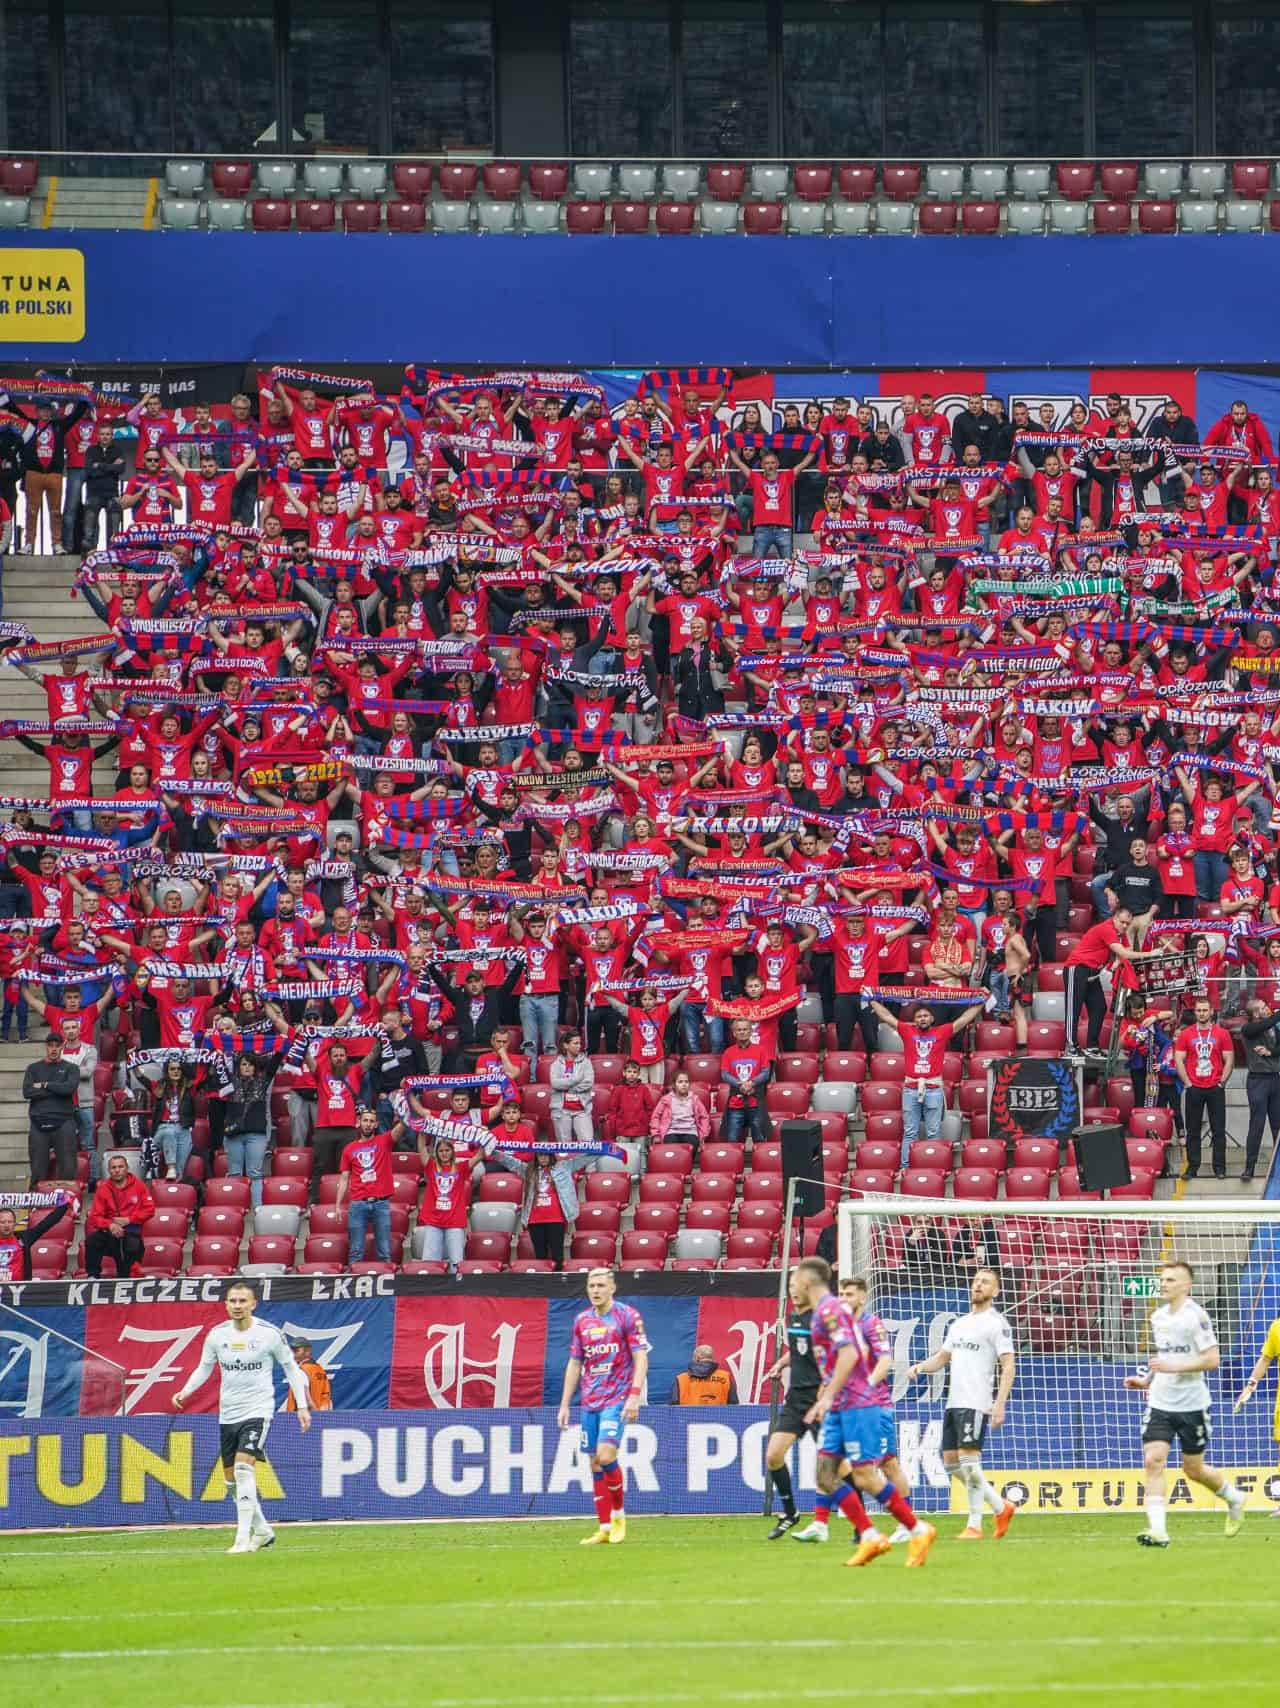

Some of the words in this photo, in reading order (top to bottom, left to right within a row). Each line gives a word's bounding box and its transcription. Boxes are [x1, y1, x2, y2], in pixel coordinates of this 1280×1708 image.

[1, 276, 71, 291] TUNA
[16, 300, 72, 314] POLSKI
[983, 658, 1005, 672] THE
[920, 687, 969, 701] OSTATNI
[251, 768, 281, 784] 1921
[306, 762, 343, 779] 2021
[278, 983, 333, 1000] MEDALIKI
[1008, 1089, 1060, 1108] 1312
